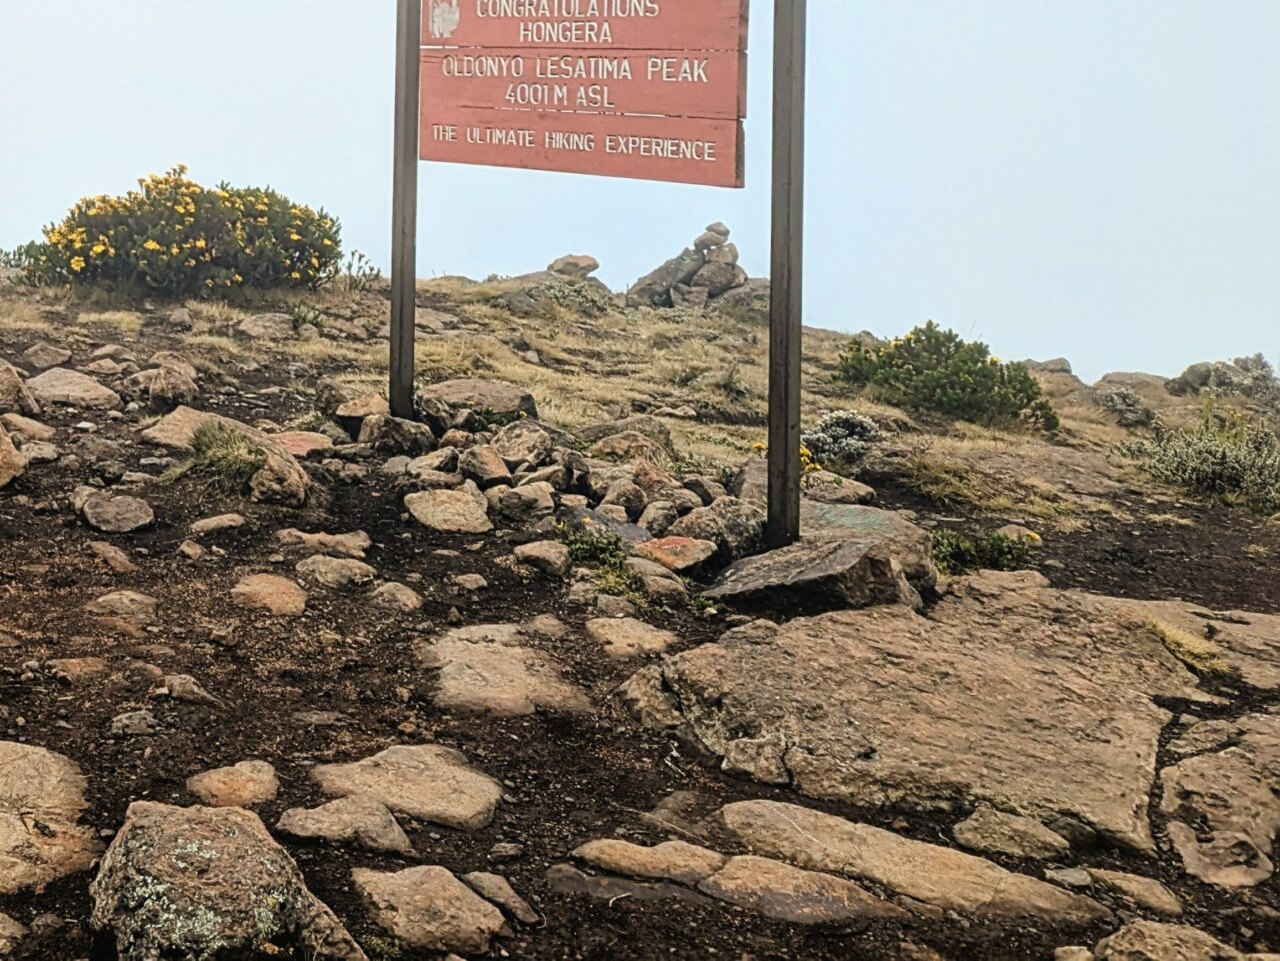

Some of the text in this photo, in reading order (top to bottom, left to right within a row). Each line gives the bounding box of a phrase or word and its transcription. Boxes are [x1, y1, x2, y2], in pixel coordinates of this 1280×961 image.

[520, 22, 612, 44] HONGERA
[442, 55, 709, 83] OLDONYO LESATIMA PEAK
[576, 85, 615, 108] ASL
[432, 124, 717, 162] THE ULTIMATE HIKING EXPERIENCE
